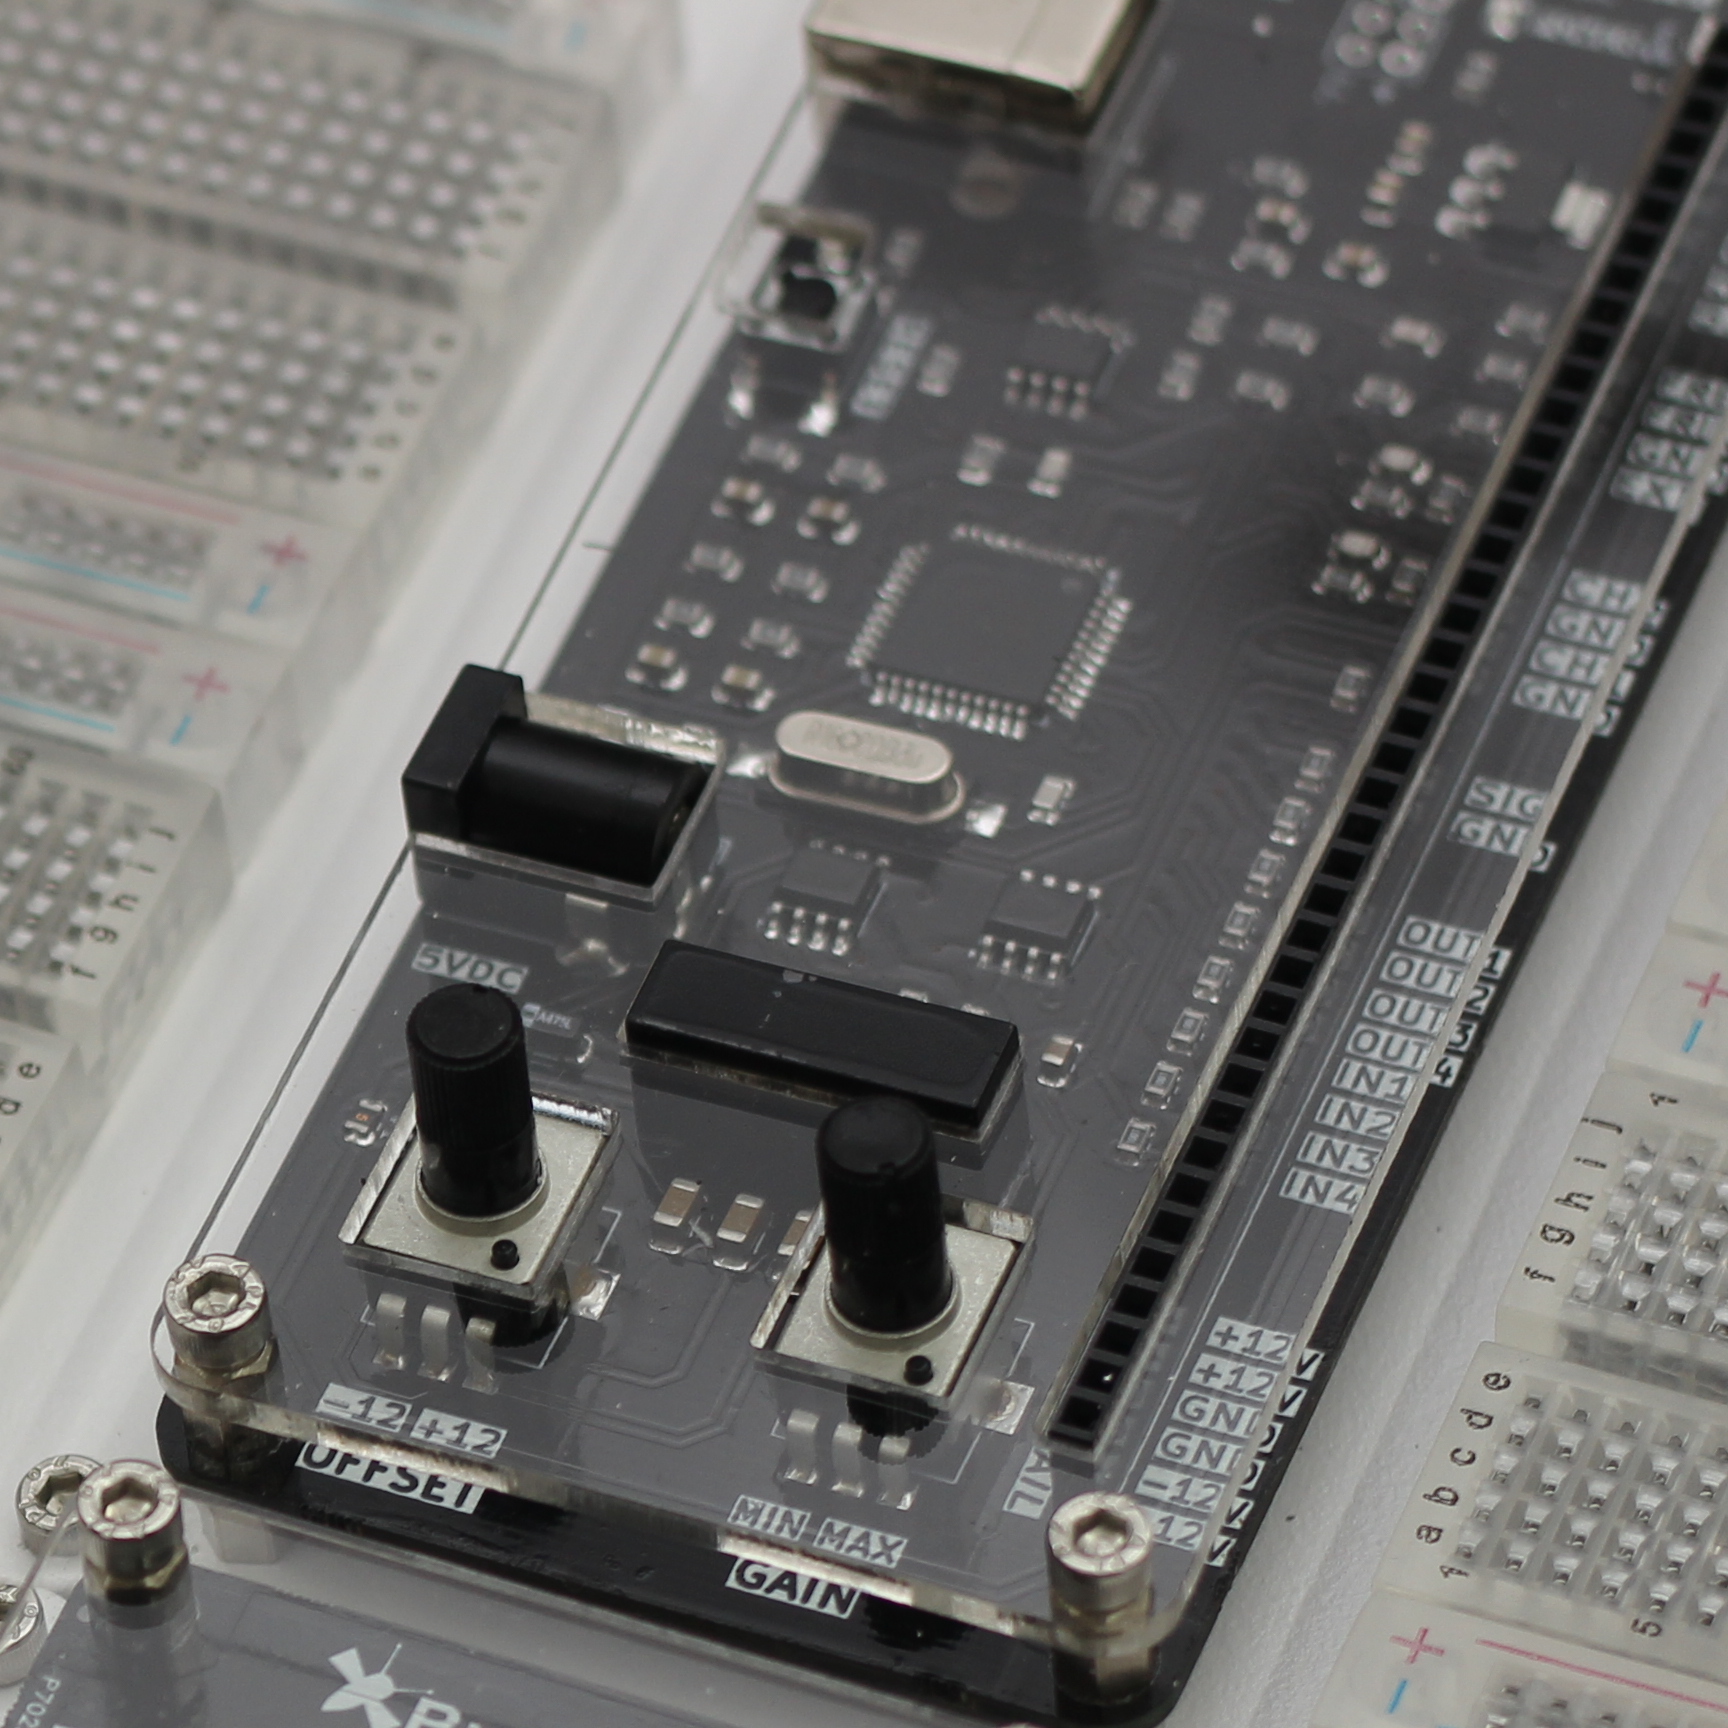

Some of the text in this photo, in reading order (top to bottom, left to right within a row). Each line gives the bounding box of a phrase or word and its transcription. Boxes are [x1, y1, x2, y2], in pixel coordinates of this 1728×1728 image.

[415, 946, 525, 991] 5VDC
[18, 1060, 42, 1081] e
[1335, 1062, 1414, 1101] IN1
[1318, 1097, 1399, 1137] IN2
[1300, 1133, 1382, 1174] IN3
[1283, 1170, 1363, 1212] IN4
[1553, 1190, 1595, 1213] h
[1540, 1222, 1575, 1245] g
[1524, 1267, 1556, 1284] f
[322, 1394, 501, 1458] -12 +12
[1416, 1371, 1512, 1545] e d c b a
[730, 1497, 905, 1566] MIN MAX
[734, 1557, 857, 1616] GAIN
[1631, 1617, 1665, 1638] 5
